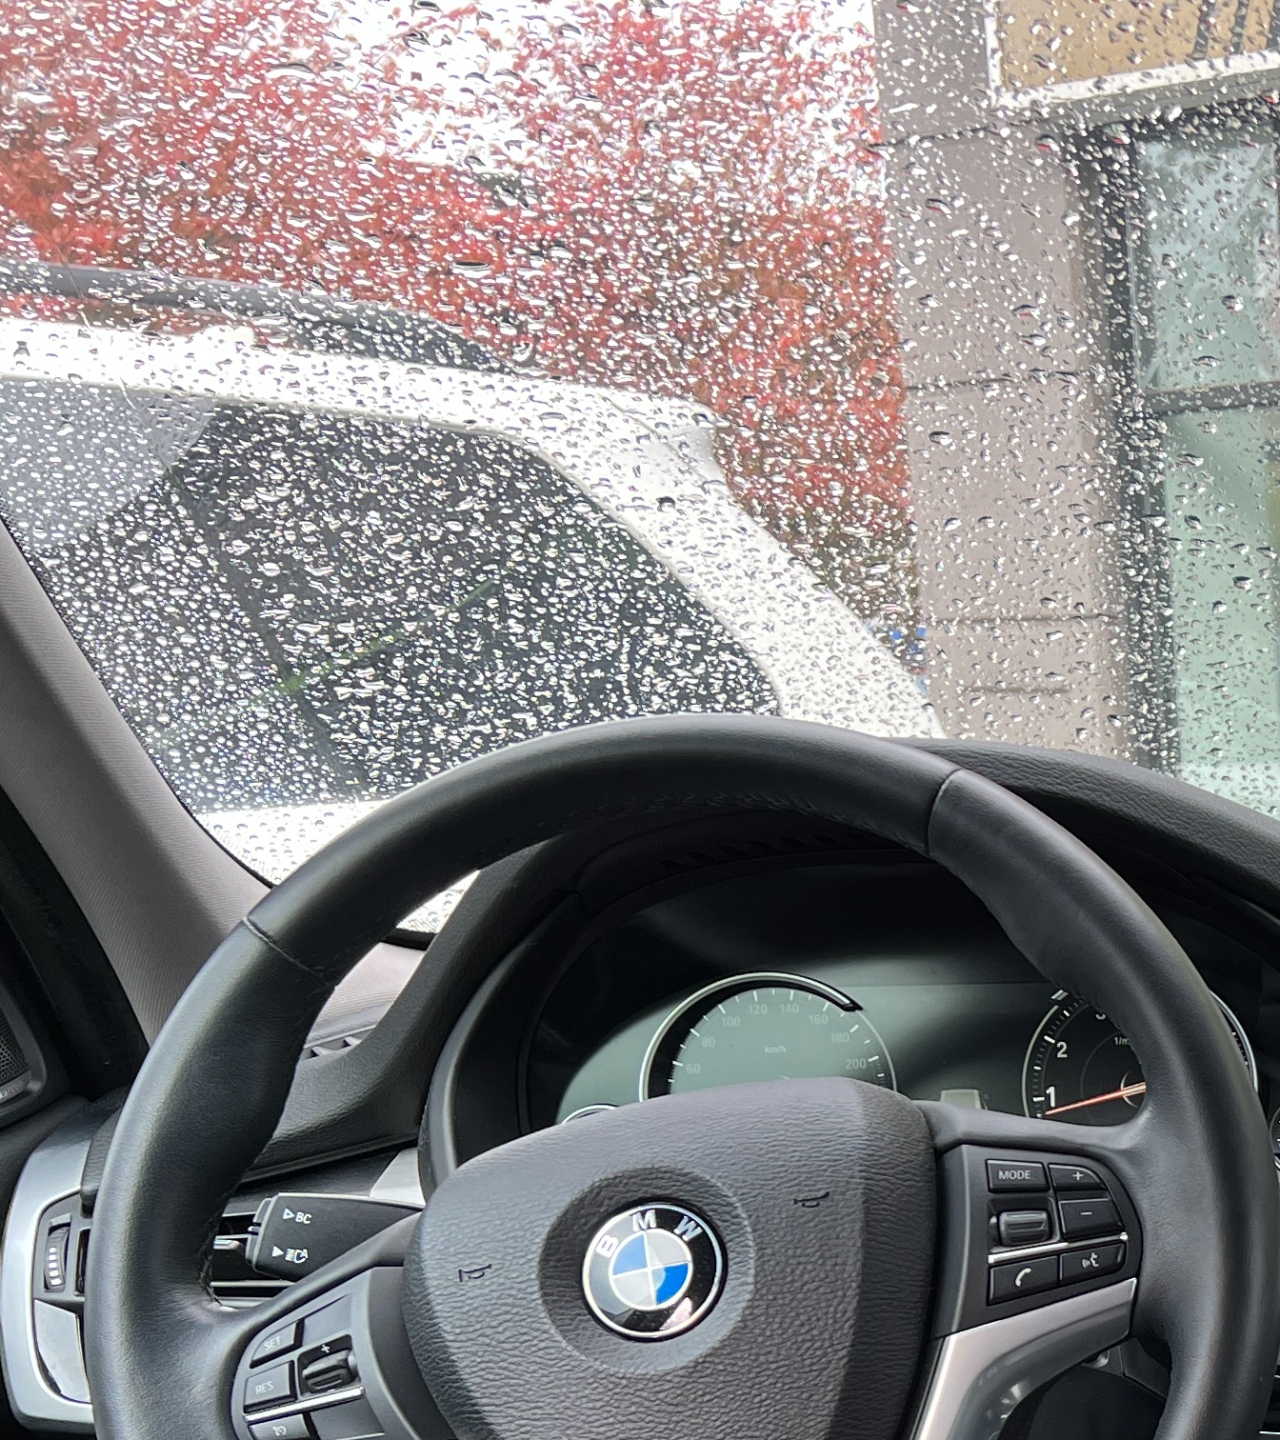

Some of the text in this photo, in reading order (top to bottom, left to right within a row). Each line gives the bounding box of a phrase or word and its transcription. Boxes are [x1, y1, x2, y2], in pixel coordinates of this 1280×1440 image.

[748, 1003, 768, 1015] 120
[780, 1003, 799, 1014] 140
[722, 1016, 741, 1028] 100
[808, 1014, 829, 1026] 160
[701, 1036, 716, 1048] 80
[831, 1032, 850, 1044] 180
[764, 1045, 786, 1054] km/h
[1056, 1042, 1068, 1058] 2
[686, 1063, 701, 1075] 60
[845, 1058, 867, 1070] 200
[1045, 1086, 1056, 1108] 1
[998, 1170, 1032, 1180] MODE
[295, 1211, 312, 1225] BC
[596, 1209, 703, 1258] BMW
[263, 1336, 281, 1351] SET
[255, 1381, 274, 1394] RES
